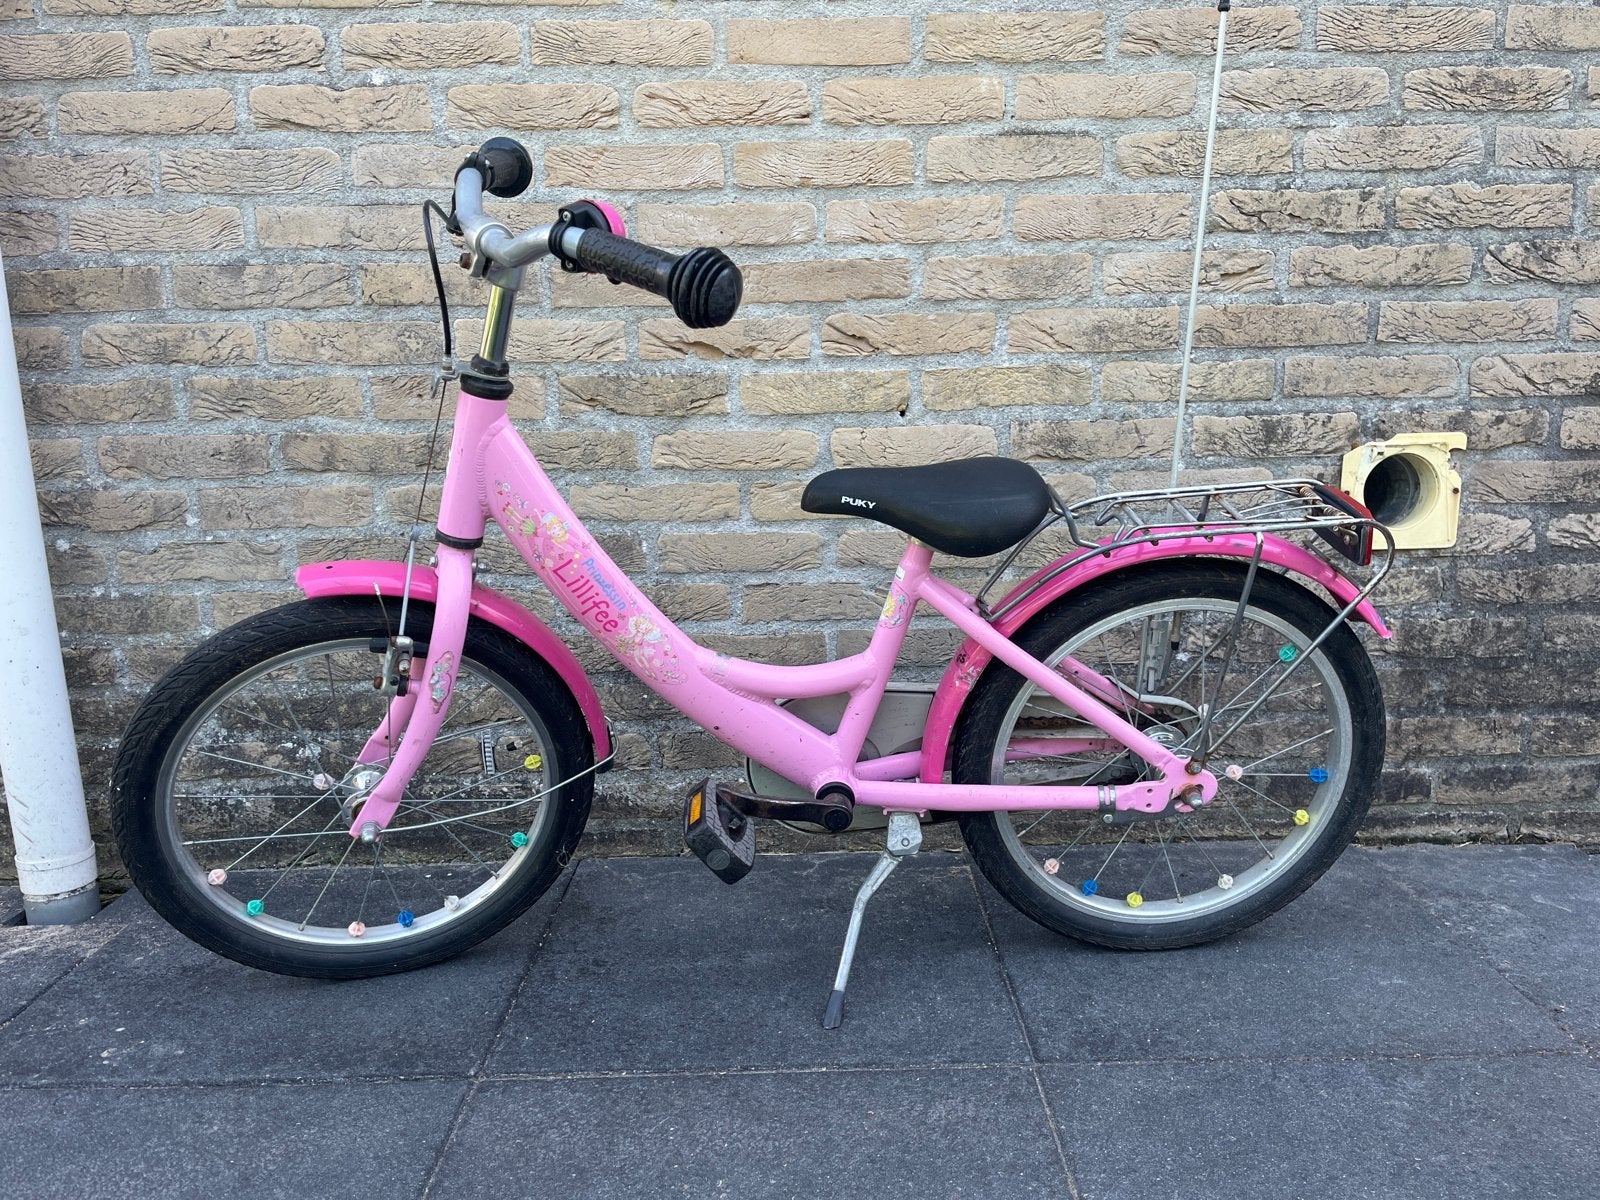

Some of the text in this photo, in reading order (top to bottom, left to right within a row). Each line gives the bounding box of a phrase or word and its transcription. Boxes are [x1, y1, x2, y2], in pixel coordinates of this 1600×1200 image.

[841, 495, 876, 509] PUKY
[552, 558, 618, 632] Lillifee
[582, 558, 626, 611] Prinzessin
